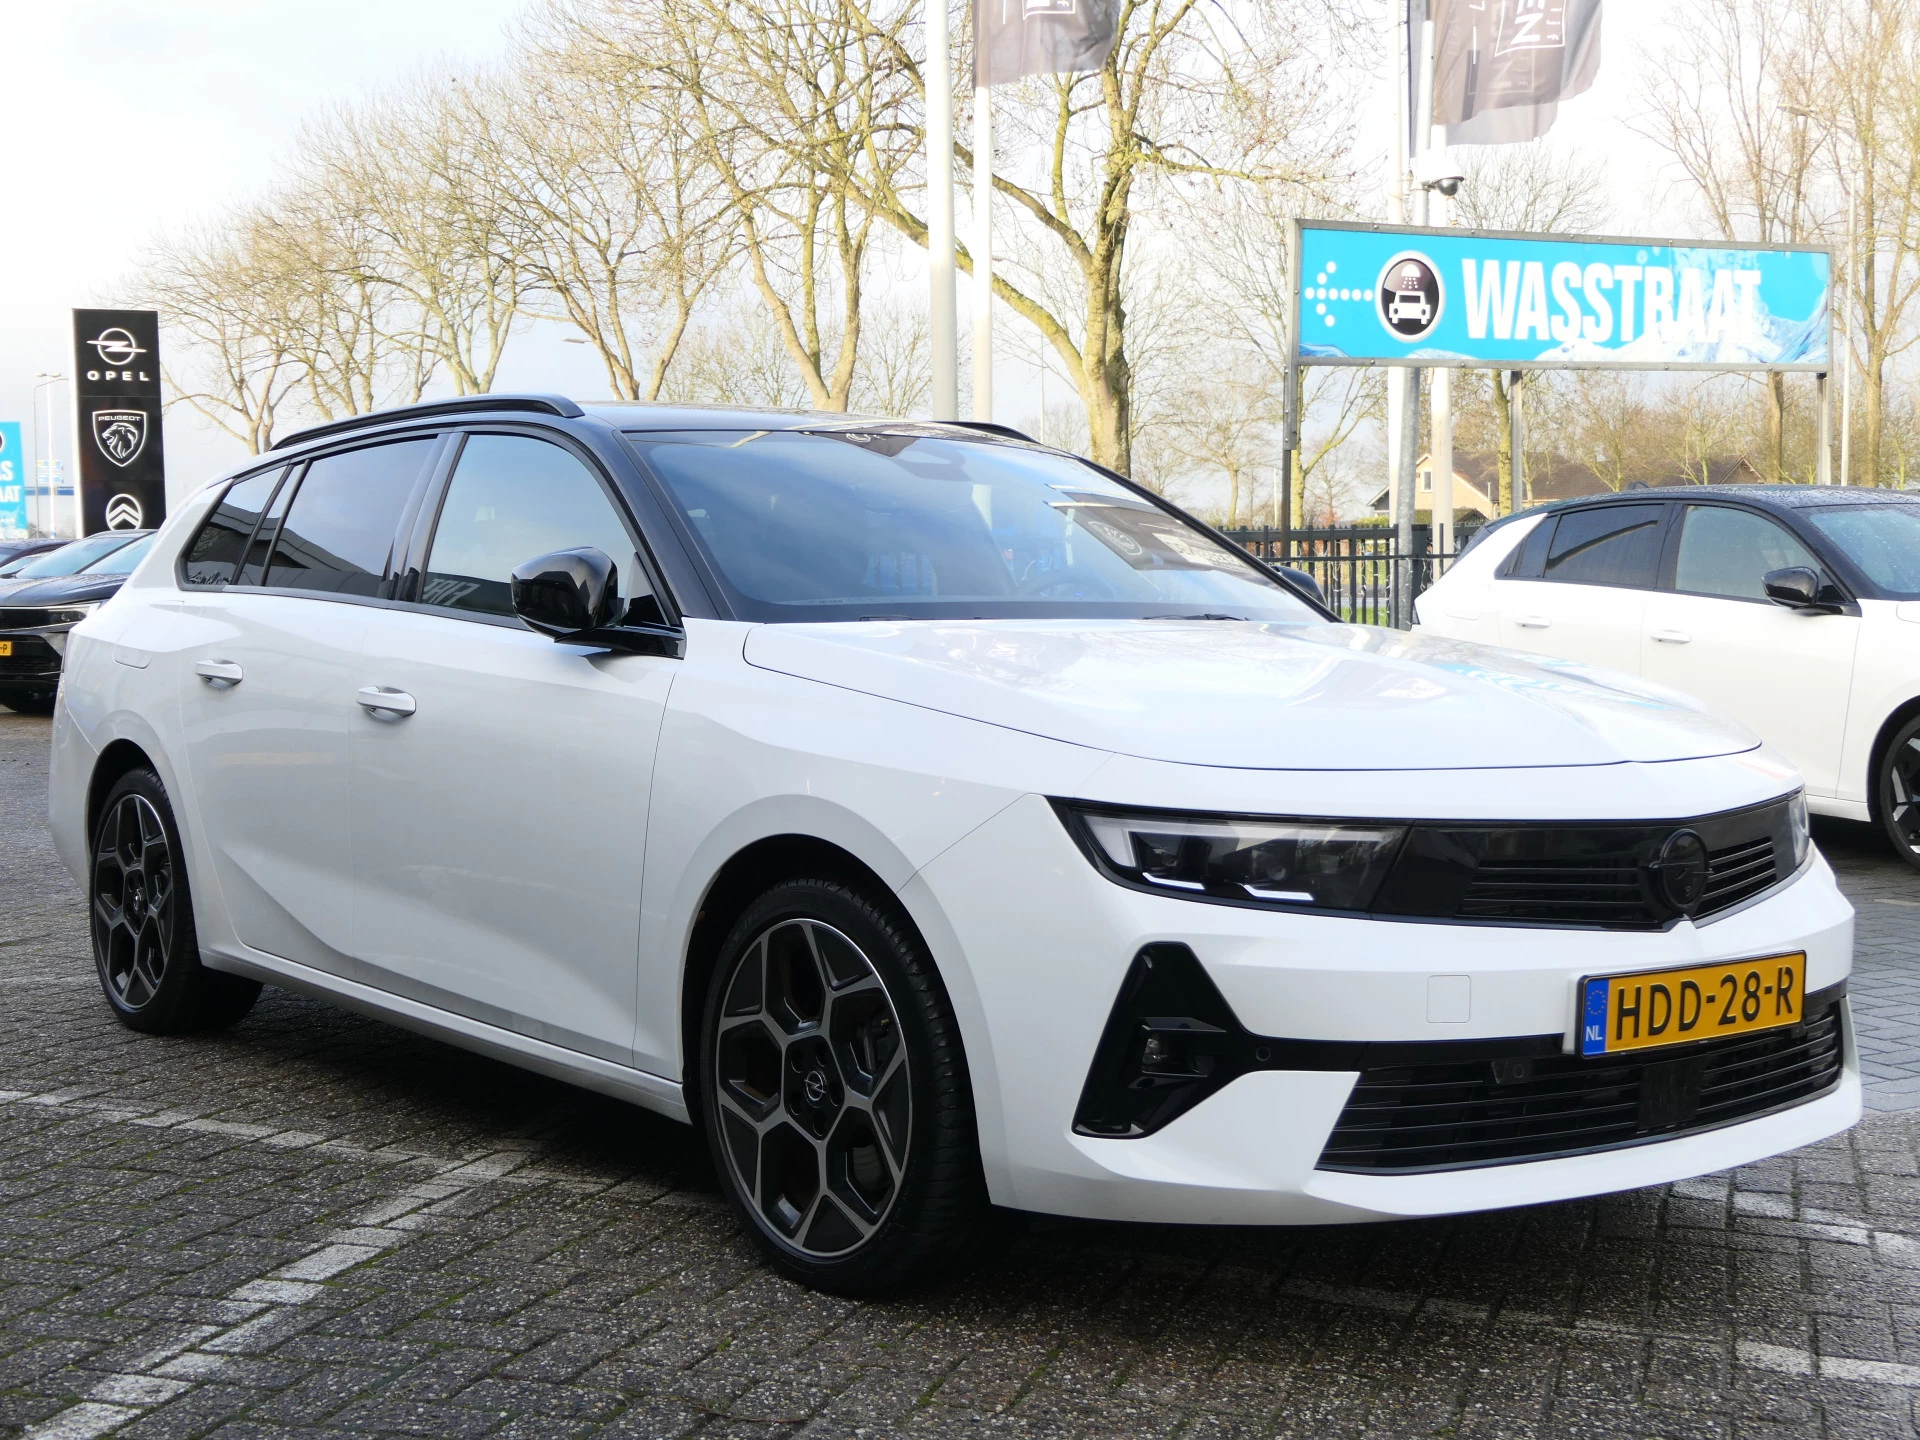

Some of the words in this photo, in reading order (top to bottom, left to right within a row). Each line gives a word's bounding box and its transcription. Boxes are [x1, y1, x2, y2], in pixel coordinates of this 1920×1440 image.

[1462, 258, 1761, 343] WASSTRAAT
[87, 370, 150, 381] OPEL
[1616, 965, 1794, 1040] HDD-28-R
[1585, 1026, 1602, 1042] NL
